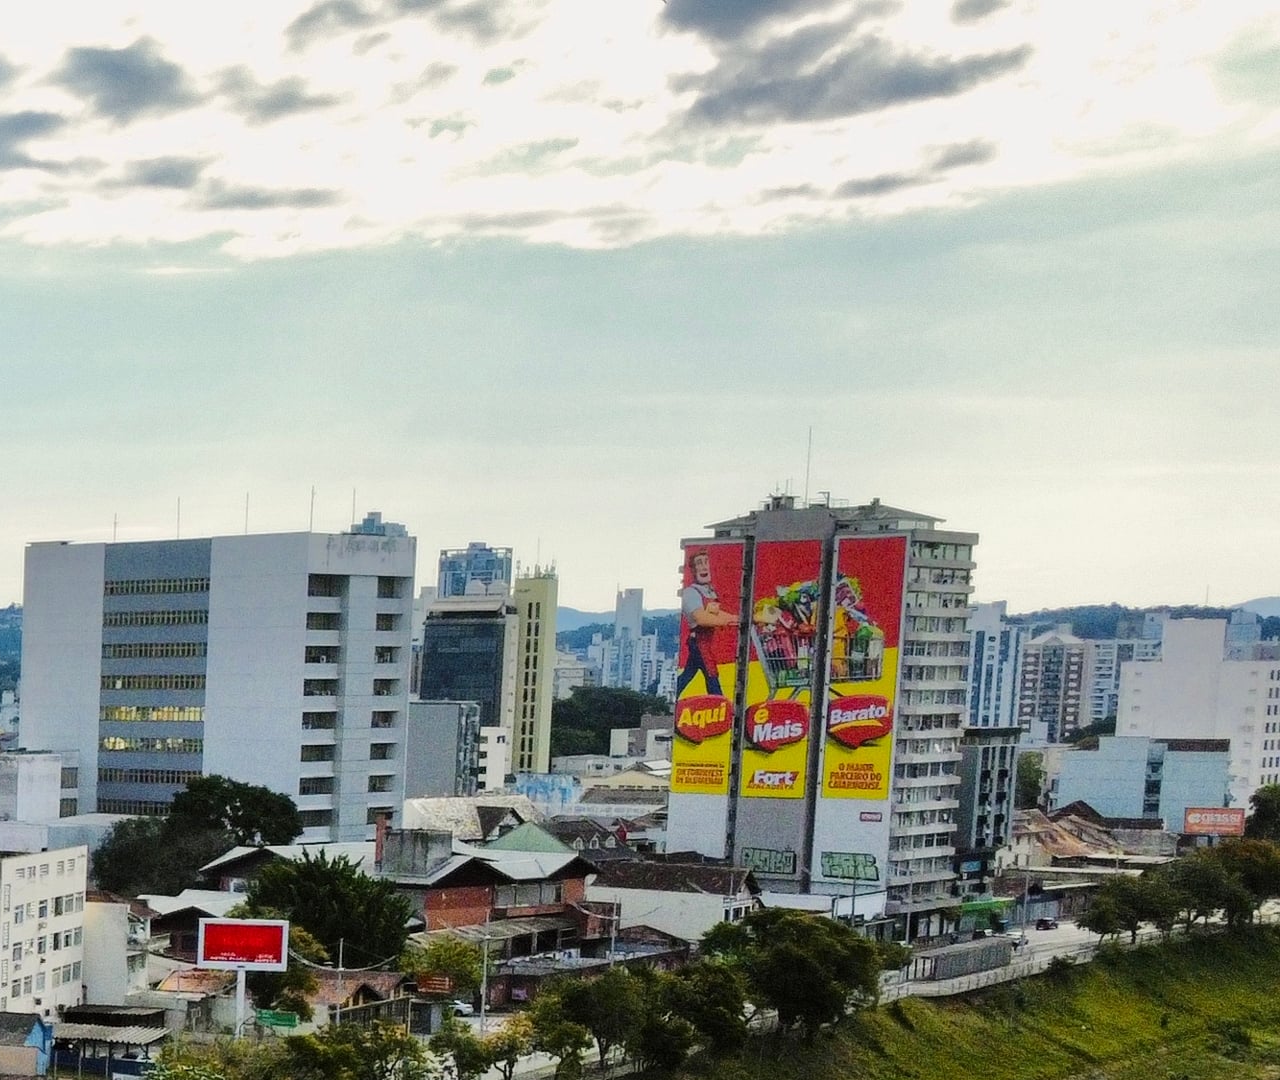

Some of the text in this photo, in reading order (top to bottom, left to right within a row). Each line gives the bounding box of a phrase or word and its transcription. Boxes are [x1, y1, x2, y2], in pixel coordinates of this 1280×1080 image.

[677, 703, 727, 729] Aqui
[754, 702, 769, 723] é
[753, 720, 803, 743] Mais
[754, 770, 795, 785] Fort
